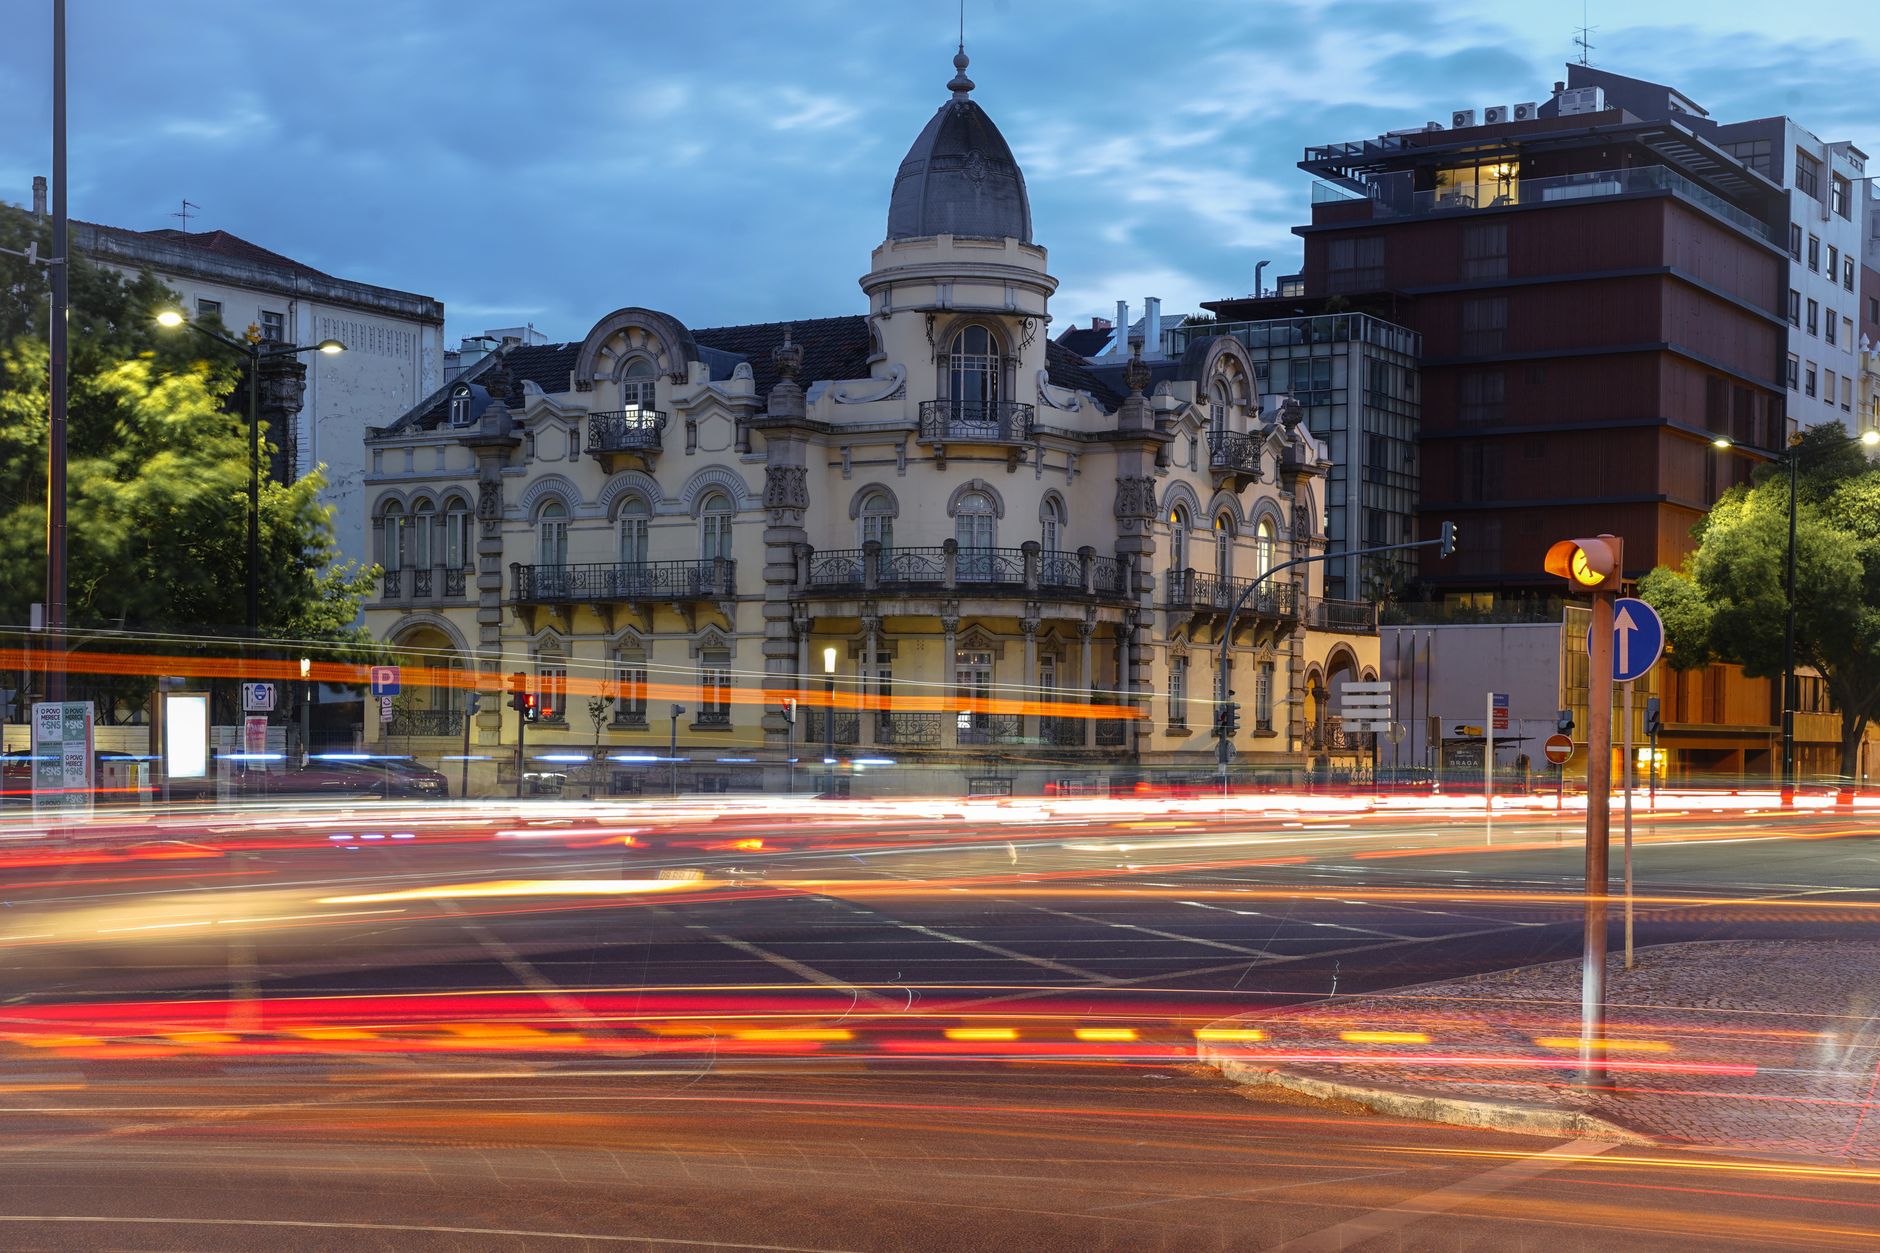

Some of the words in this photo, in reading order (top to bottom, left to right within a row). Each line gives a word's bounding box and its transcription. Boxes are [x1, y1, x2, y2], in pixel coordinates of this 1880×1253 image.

[378, 669, 394, 693] P
[40, 720, 61, 729] +SNS
[65, 720, 84, 729] +SNS
